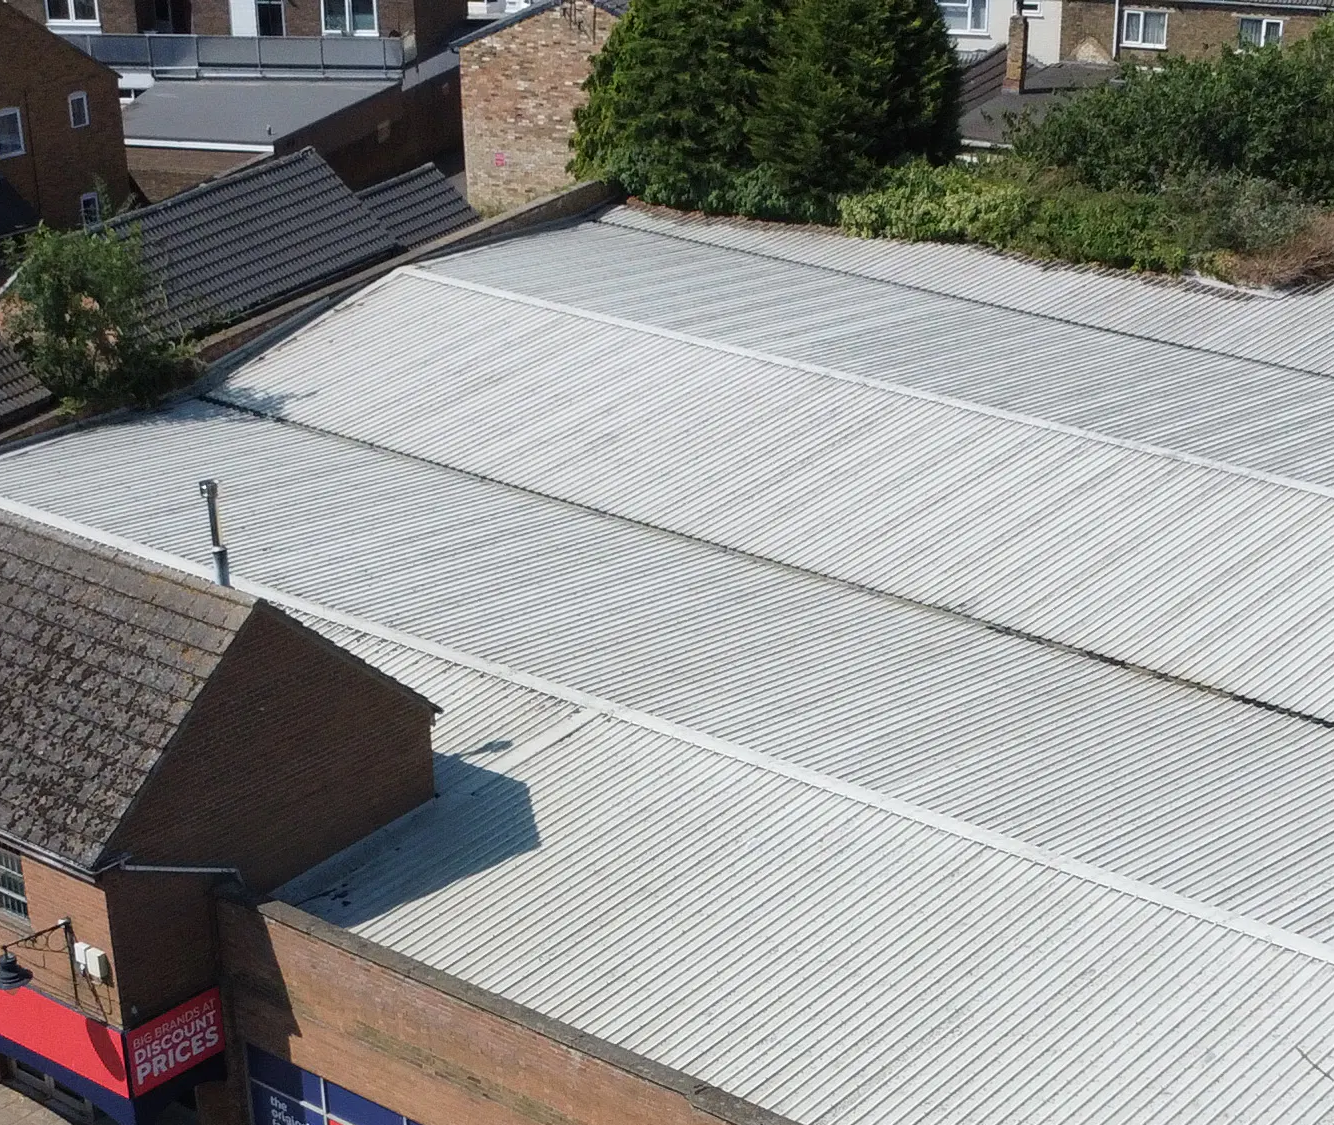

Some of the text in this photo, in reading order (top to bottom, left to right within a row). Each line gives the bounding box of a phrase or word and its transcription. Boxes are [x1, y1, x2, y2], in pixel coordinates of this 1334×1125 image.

[133, 998, 216, 1049] BIG BRANDS AT
[134, 1010, 217, 1065] DISCOUNT
[136, 1025, 220, 1086] PRICES
[270, 1096, 288, 1112] the
